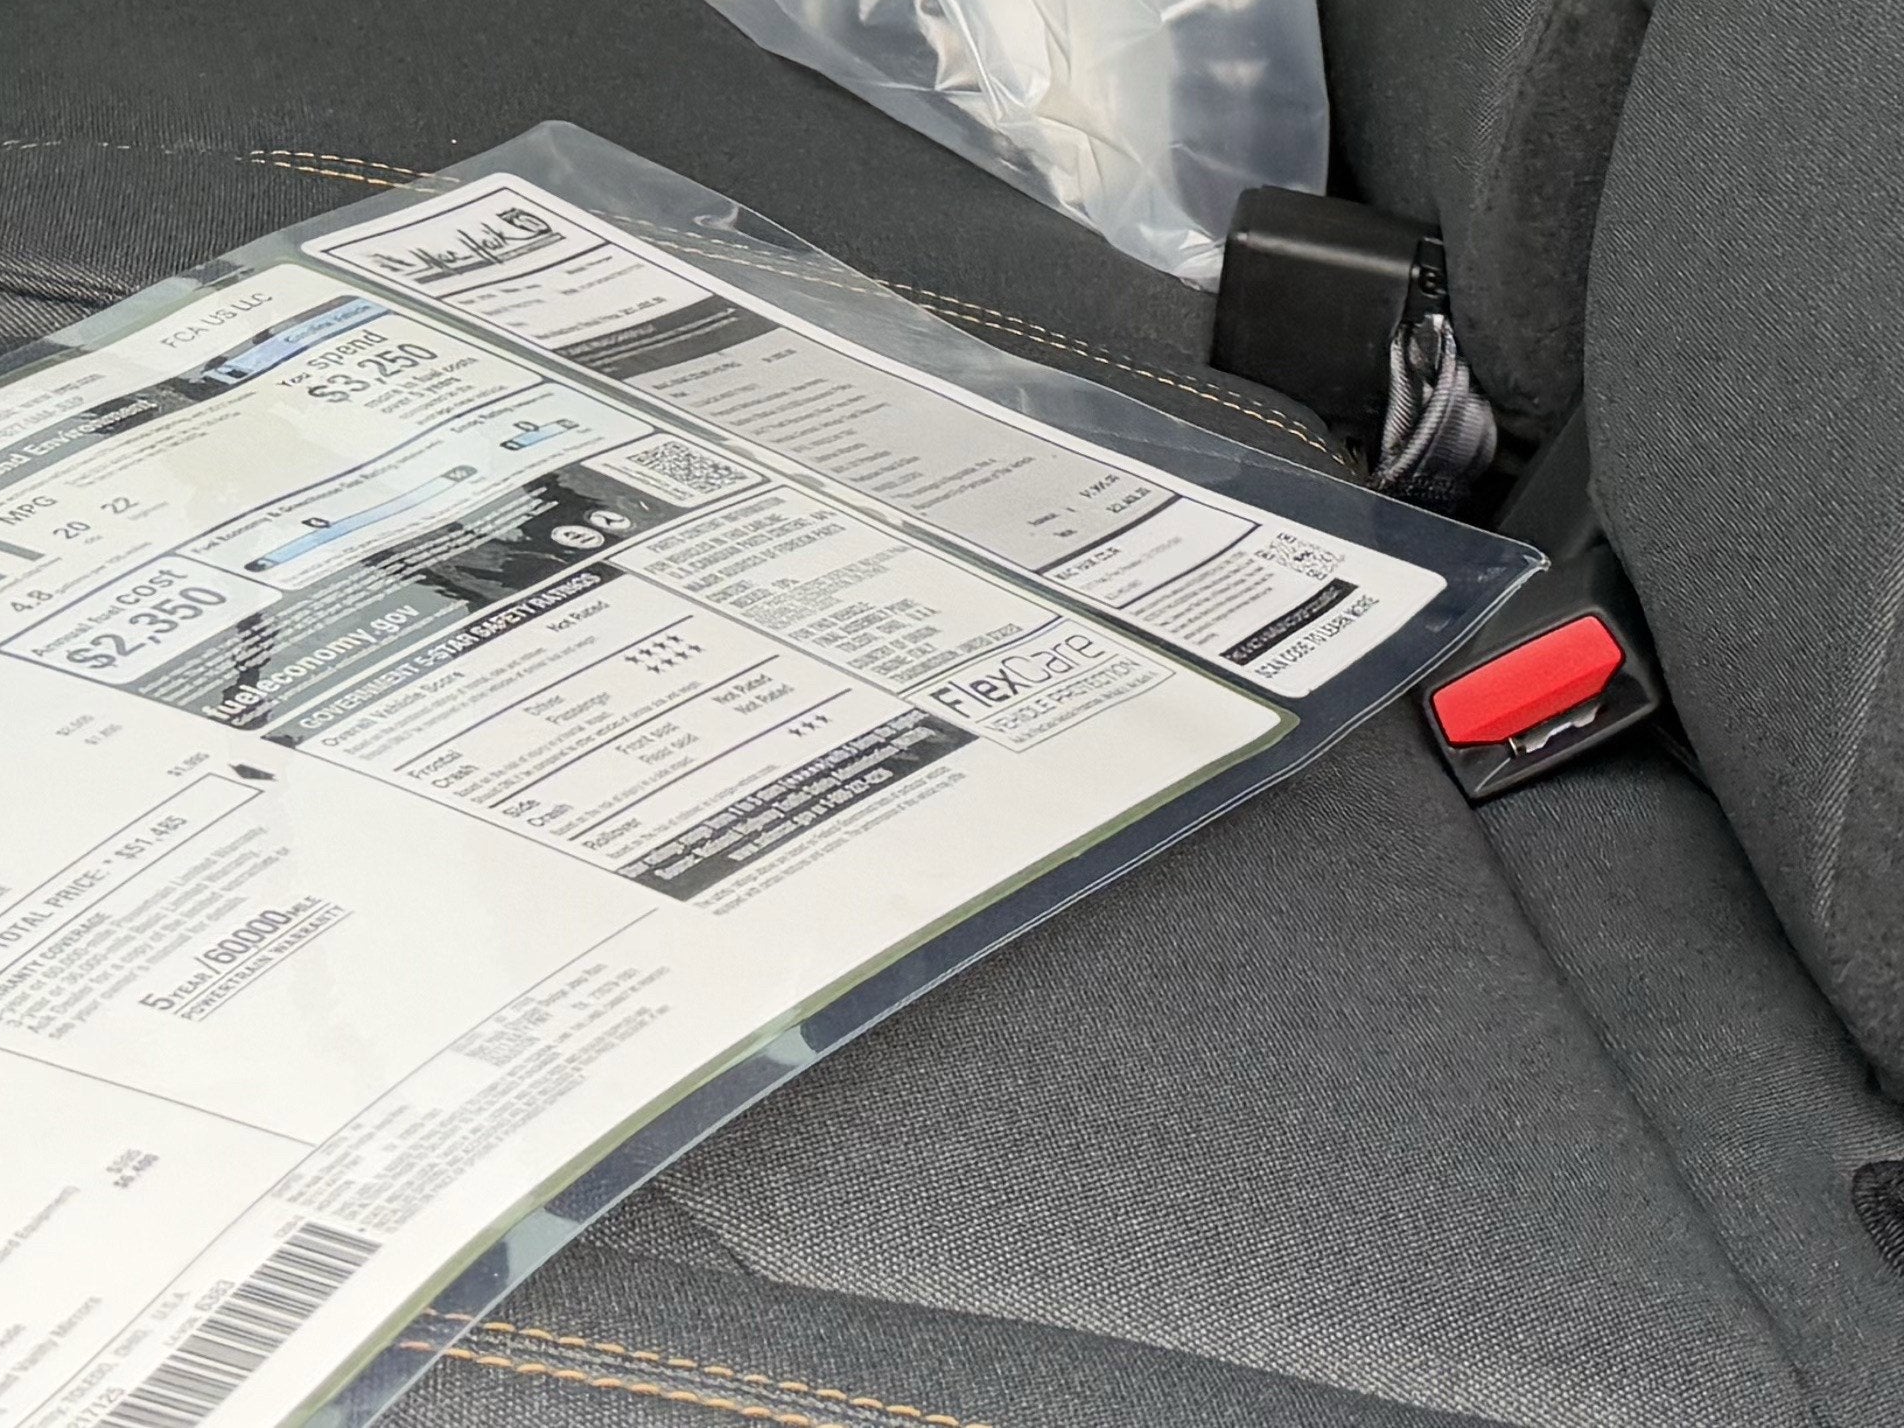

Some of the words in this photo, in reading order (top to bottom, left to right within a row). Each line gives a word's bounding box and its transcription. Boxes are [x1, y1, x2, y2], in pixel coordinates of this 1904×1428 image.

[159, 322, 211, 349] FCA
[200, 307, 239, 326] US
[230, 290, 275, 313] LLC
[275, 370, 313, 389] You
[303, 327, 389, 373] spend
[301, 338, 440, 409] $3,250
[49, 518, 93, 540] 20
[99, 495, 140, 515] 22
[5, 587, 56, 614] 4.8
[29, 621, 95, 657] Annual
[112, 566, 190, 607] cost
[57, 580, 231, 675] $2,350
[198, 603, 424, 721] fueleconomy.gov
[296, 662, 423, 731] GOVERNMENT
[410, 631, 479, 667] 5-STAR
[467, 601, 540, 638] SAFETY
[924, 631, 1111, 718] FlexCare
[320, 716, 378, 748] Overall
[369, 690, 426, 720] Vehicle
[42, 866, 111, 909] PRICE:
[112, 813, 192, 862] $51,485
[177, 954, 276, 1021] POWERTRAIN
[267, 904, 349, 957] WARRANTY
